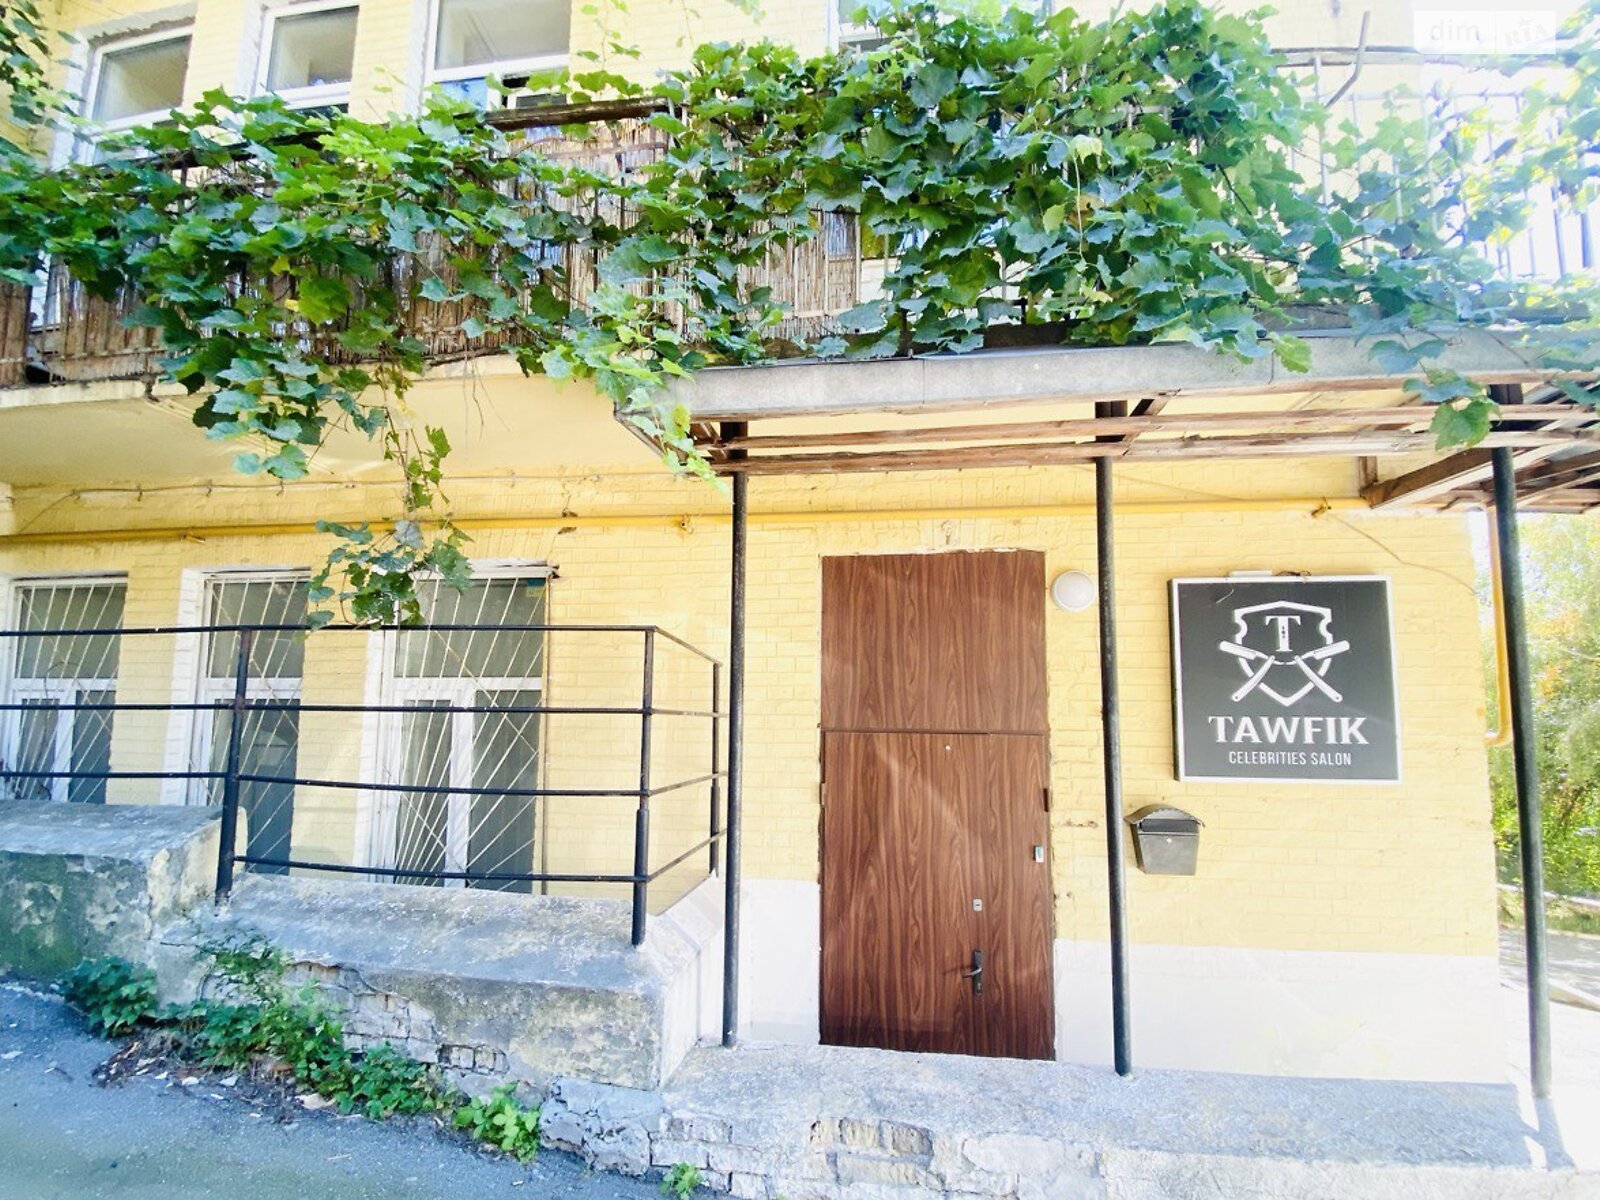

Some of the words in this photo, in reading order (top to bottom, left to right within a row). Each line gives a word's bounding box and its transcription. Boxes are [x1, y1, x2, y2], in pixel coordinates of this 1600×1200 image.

[1265, 615, 1301, 651] T
[1208, 716, 1369, 745] TAWFIK
[1229, 751, 1307, 765] CELEBRITIES
[1311, 752, 1352, 766] SALON
